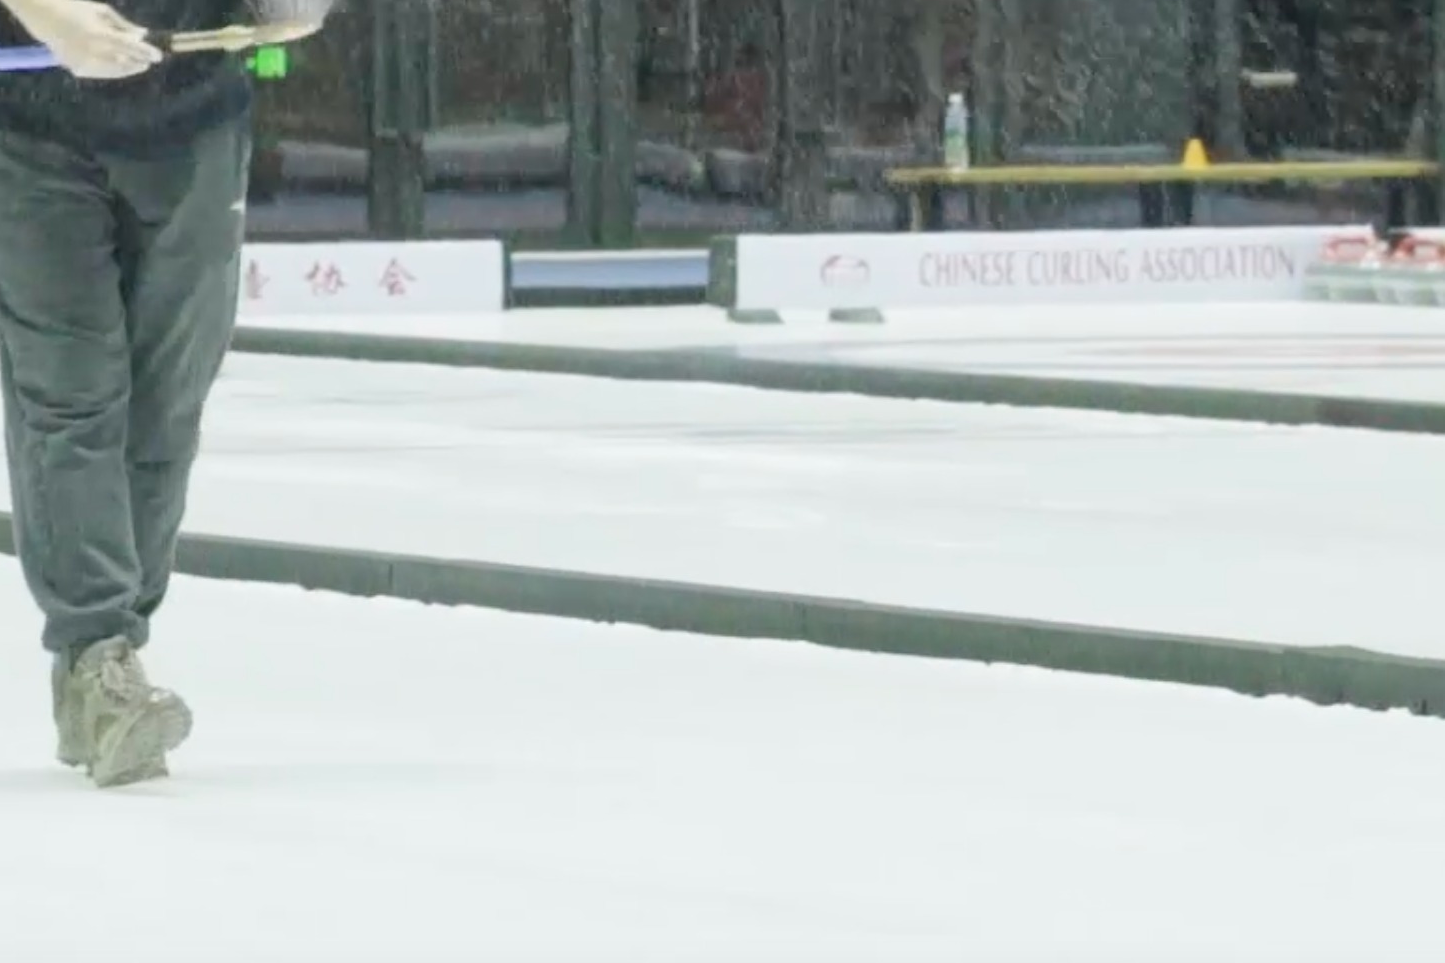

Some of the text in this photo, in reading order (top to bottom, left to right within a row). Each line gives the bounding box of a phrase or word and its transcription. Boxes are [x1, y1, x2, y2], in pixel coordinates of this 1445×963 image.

[918, 244, 1296, 287] CHINESE CURLING ASSOCIATION
